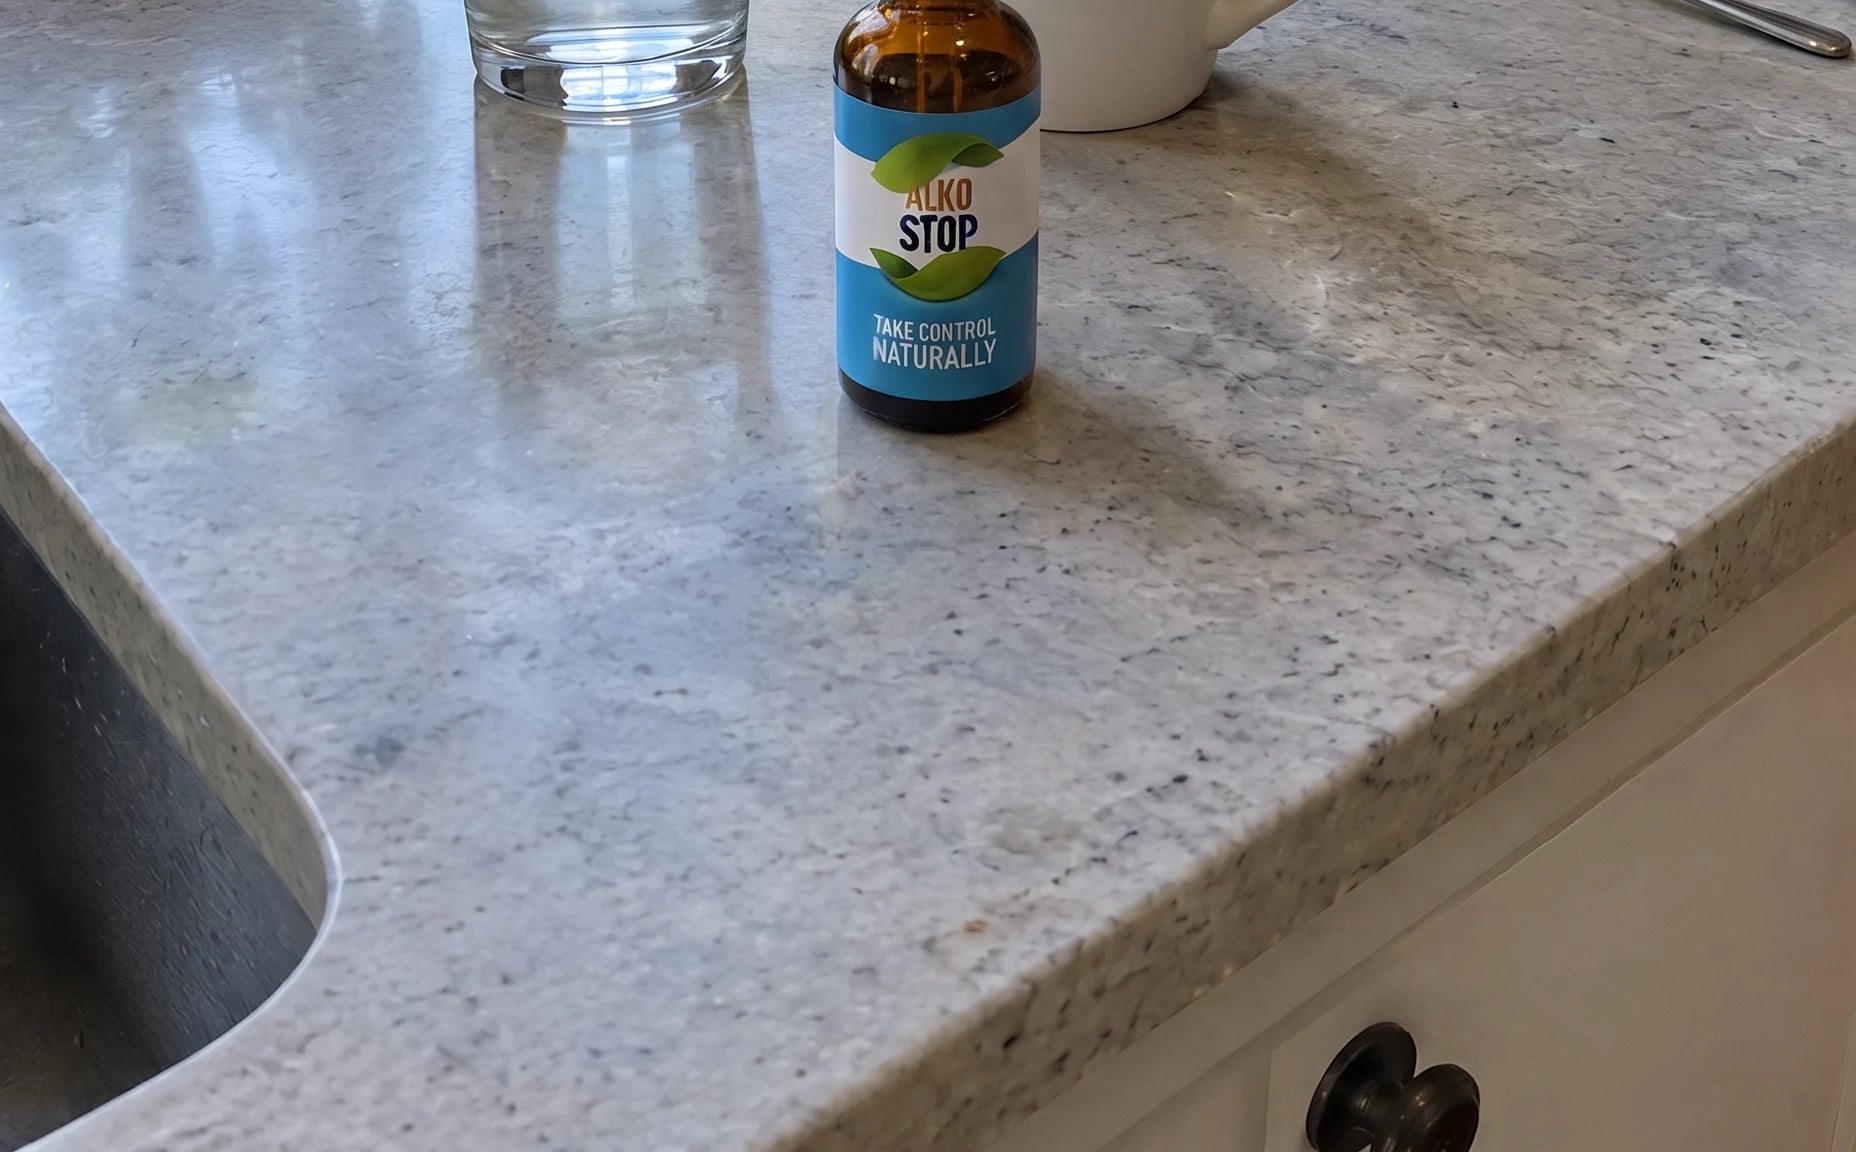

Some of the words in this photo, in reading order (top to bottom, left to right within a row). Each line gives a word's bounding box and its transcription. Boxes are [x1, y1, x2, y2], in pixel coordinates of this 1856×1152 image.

[905, 178, 972, 212] ALKO
[899, 214, 978, 253] STOP
[873, 313, 914, 341] TAKE
[919, 317, 996, 342] CONTROL
[872, 336, 997, 370] NATURALLY
